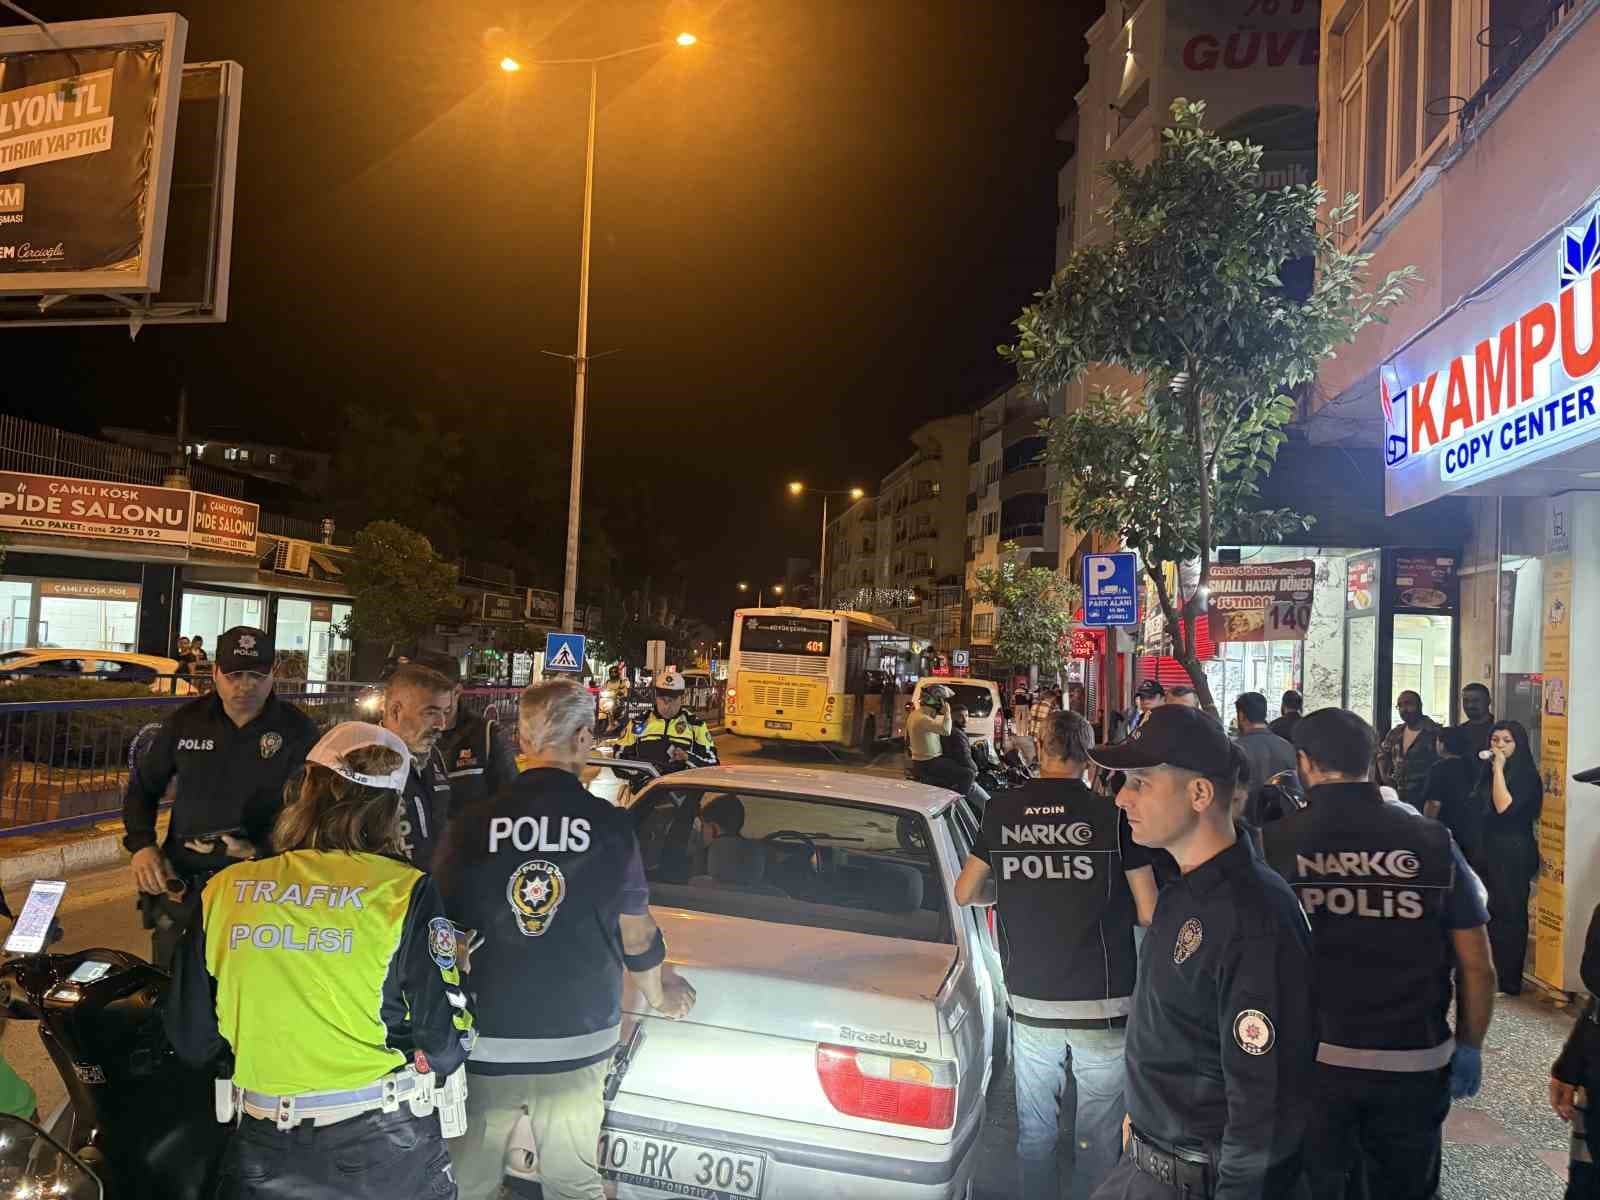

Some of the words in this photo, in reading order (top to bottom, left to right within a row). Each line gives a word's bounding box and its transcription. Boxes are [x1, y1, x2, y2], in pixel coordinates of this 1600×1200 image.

[0, 91, 65, 134] LYON
[72, 84, 102, 117] TL
[0, 140, 42, 163] TIRIM
[46, 125, 107, 154] YAPTIK!
[1411, 267, 1600, 453] KAMPU
[1445, 431, 1494, 474] COPY
[1500, 384, 1597, 451] CENTER
[48, 482, 96, 497] ÇAMLI
[70, 500, 183, 526] SALONU
[20, 518, 45, 528] ALO
[109, 526, 130, 536] 225
[132, 528, 144, 537] 78
[147, 529, 161, 538] 92
[219, 516, 254, 537] SALONU
[1088, 556, 1116, 596] P
[1208, 579, 1244, 593] SMALL
[1245, 578, 1278, 592] HATAY
[1279, 574, 1313, 592] DÖNER
[1088, 600, 1109, 608] PARK
[1269, 605, 1310, 632] 140
[1024, 805, 1065, 816] AYDIN
[598, 1133, 628, 1169] 10
[640, 1141, 680, 1180] RK
[695, 1150, 754, 1193] 305
